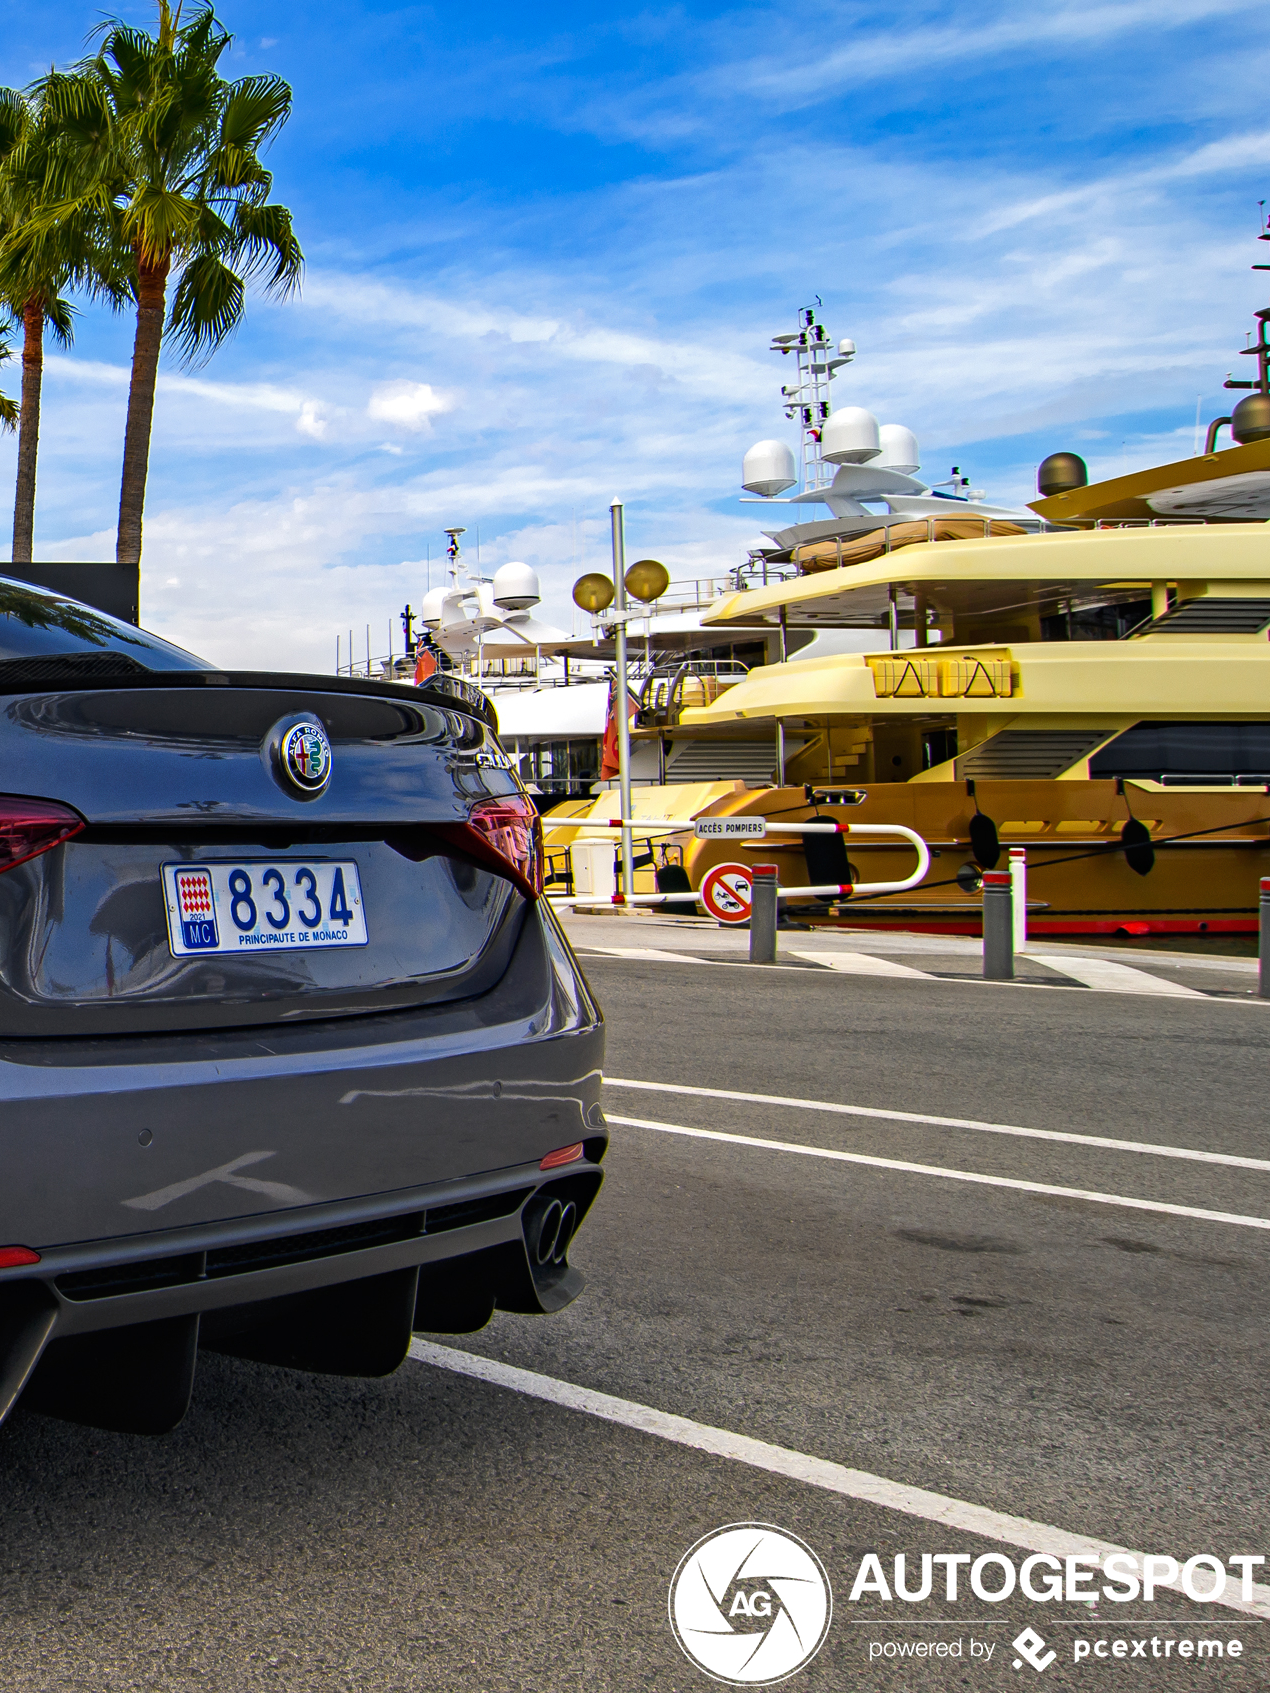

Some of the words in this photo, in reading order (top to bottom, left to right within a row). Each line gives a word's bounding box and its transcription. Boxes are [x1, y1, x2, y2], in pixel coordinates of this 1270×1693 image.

[289, 731, 303, 757] ALFA
[304, 727, 330, 758] ROMEO
[698, 822, 723, 833] ACCÈS
[725, 823, 763, 833] POMPIERS
[228, 867, 353, 931] 8334
[189, 913, 206, 921] 2021
[189, 924, 211, 945] MC
[238, 933, 296, 946] PRINCIPAUTE
[298, 932, 311, 943] DE
[312, 930, 348, 942] MONACO
